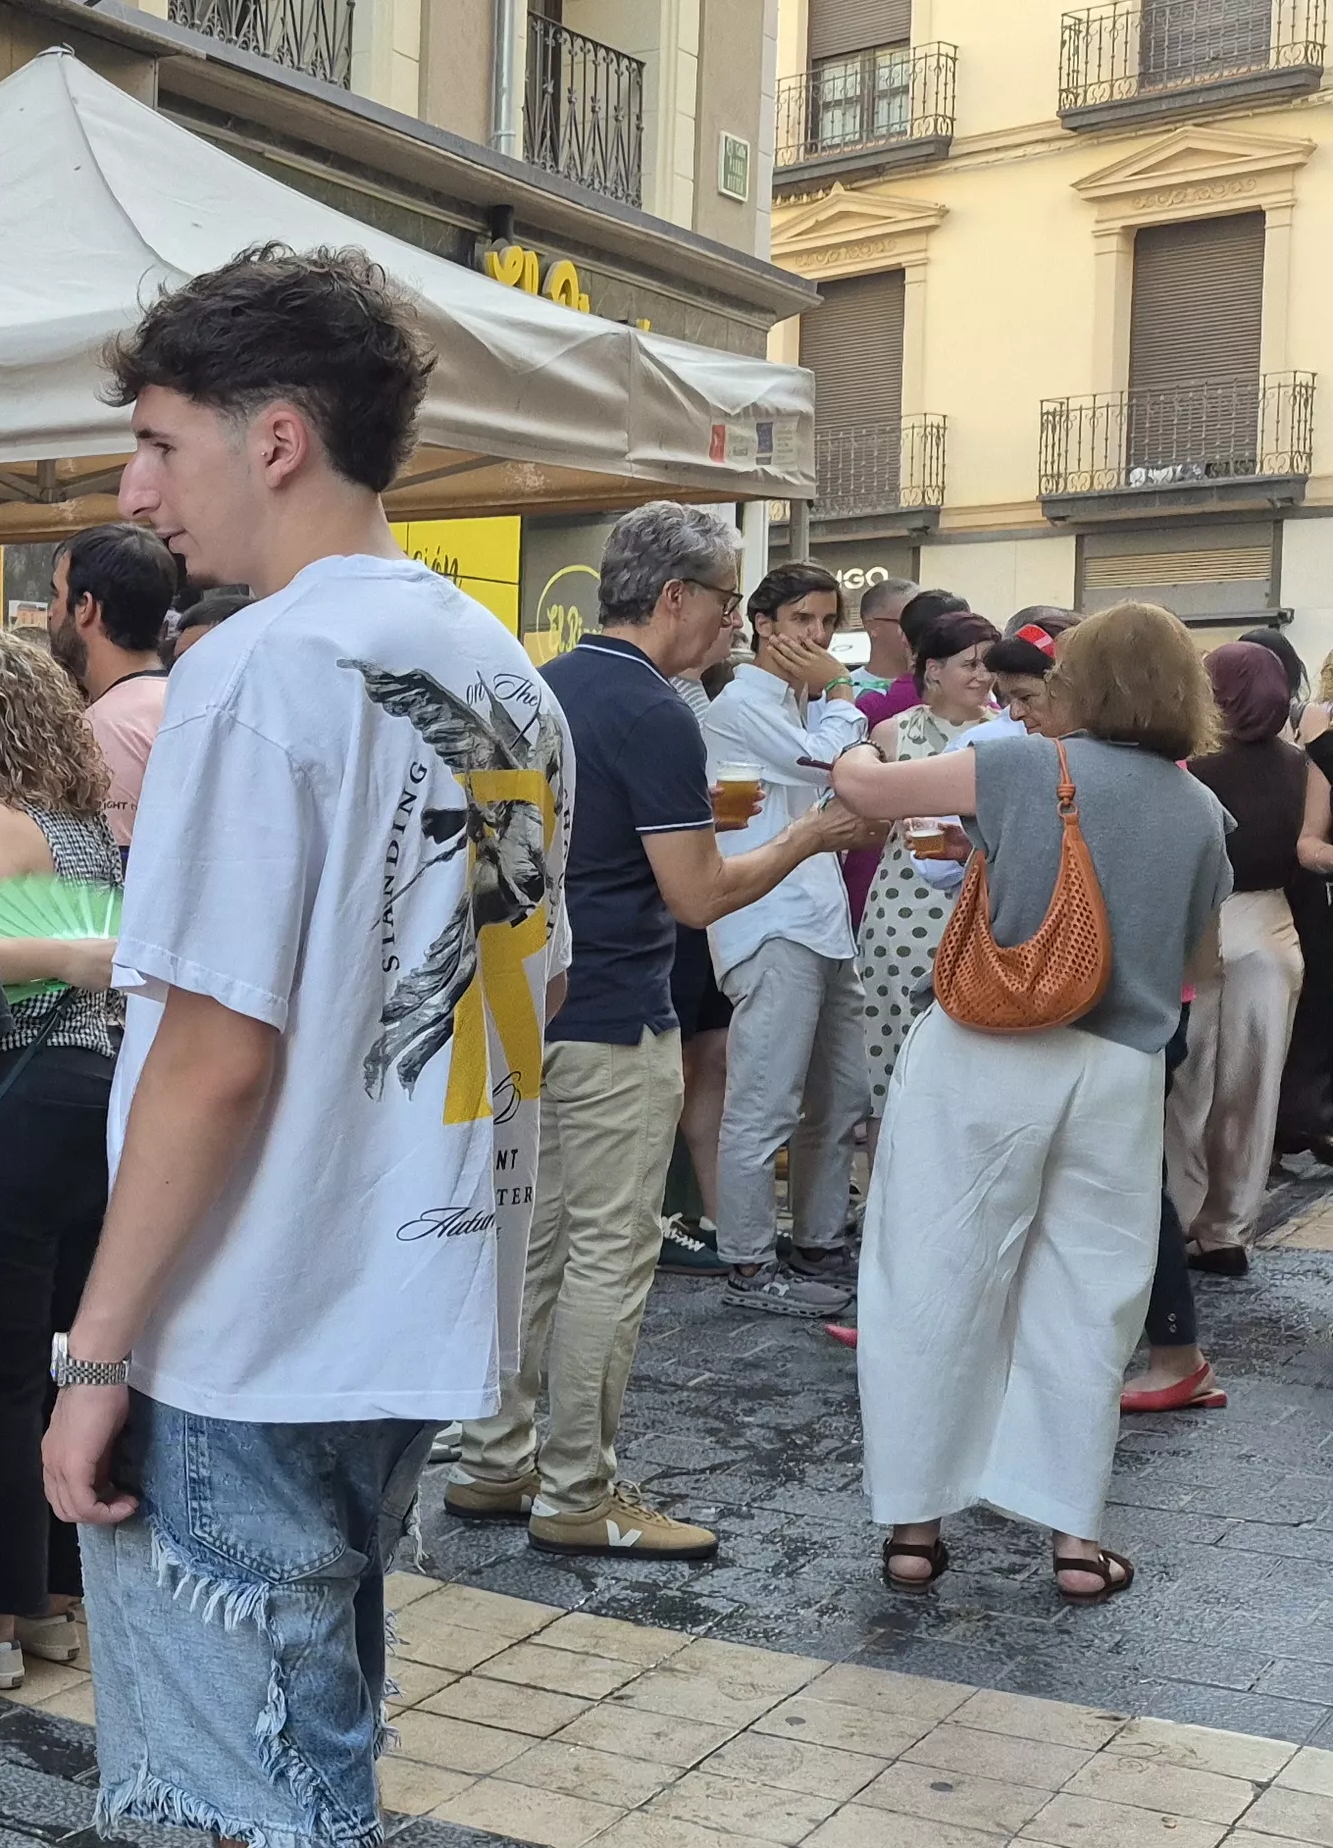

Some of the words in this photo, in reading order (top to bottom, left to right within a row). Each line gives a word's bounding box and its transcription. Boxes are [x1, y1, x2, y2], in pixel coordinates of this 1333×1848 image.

[382, 761, 429, 974] STANDING
[496, 1149, 519, 1171] NT
[497, 1186, 533, 1206] TER
